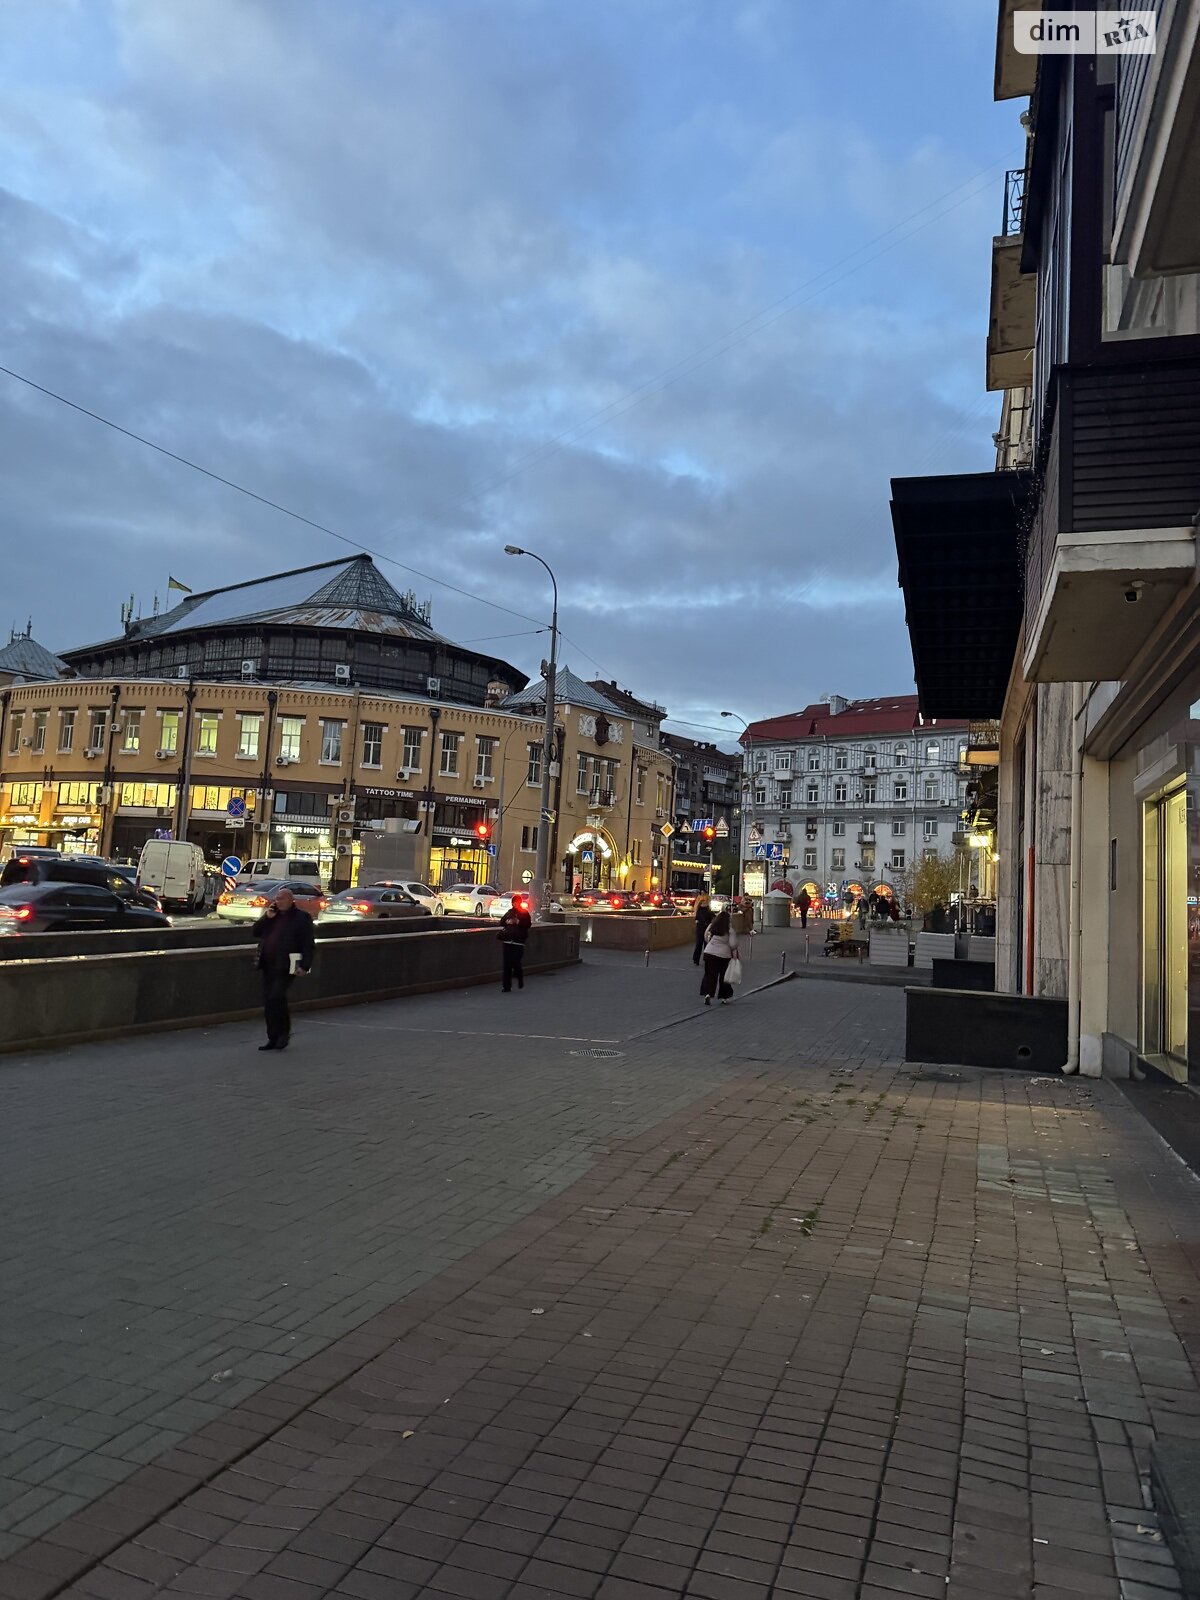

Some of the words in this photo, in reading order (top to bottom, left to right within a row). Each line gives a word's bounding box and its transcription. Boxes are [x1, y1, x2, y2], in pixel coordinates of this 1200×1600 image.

[365, 788, 395, 797] TATTOO
[396, 790, 414, 798] TIME
[445, 795, 487, 806] PERMANENT
[303, 826, 330, 835] HOUSE
